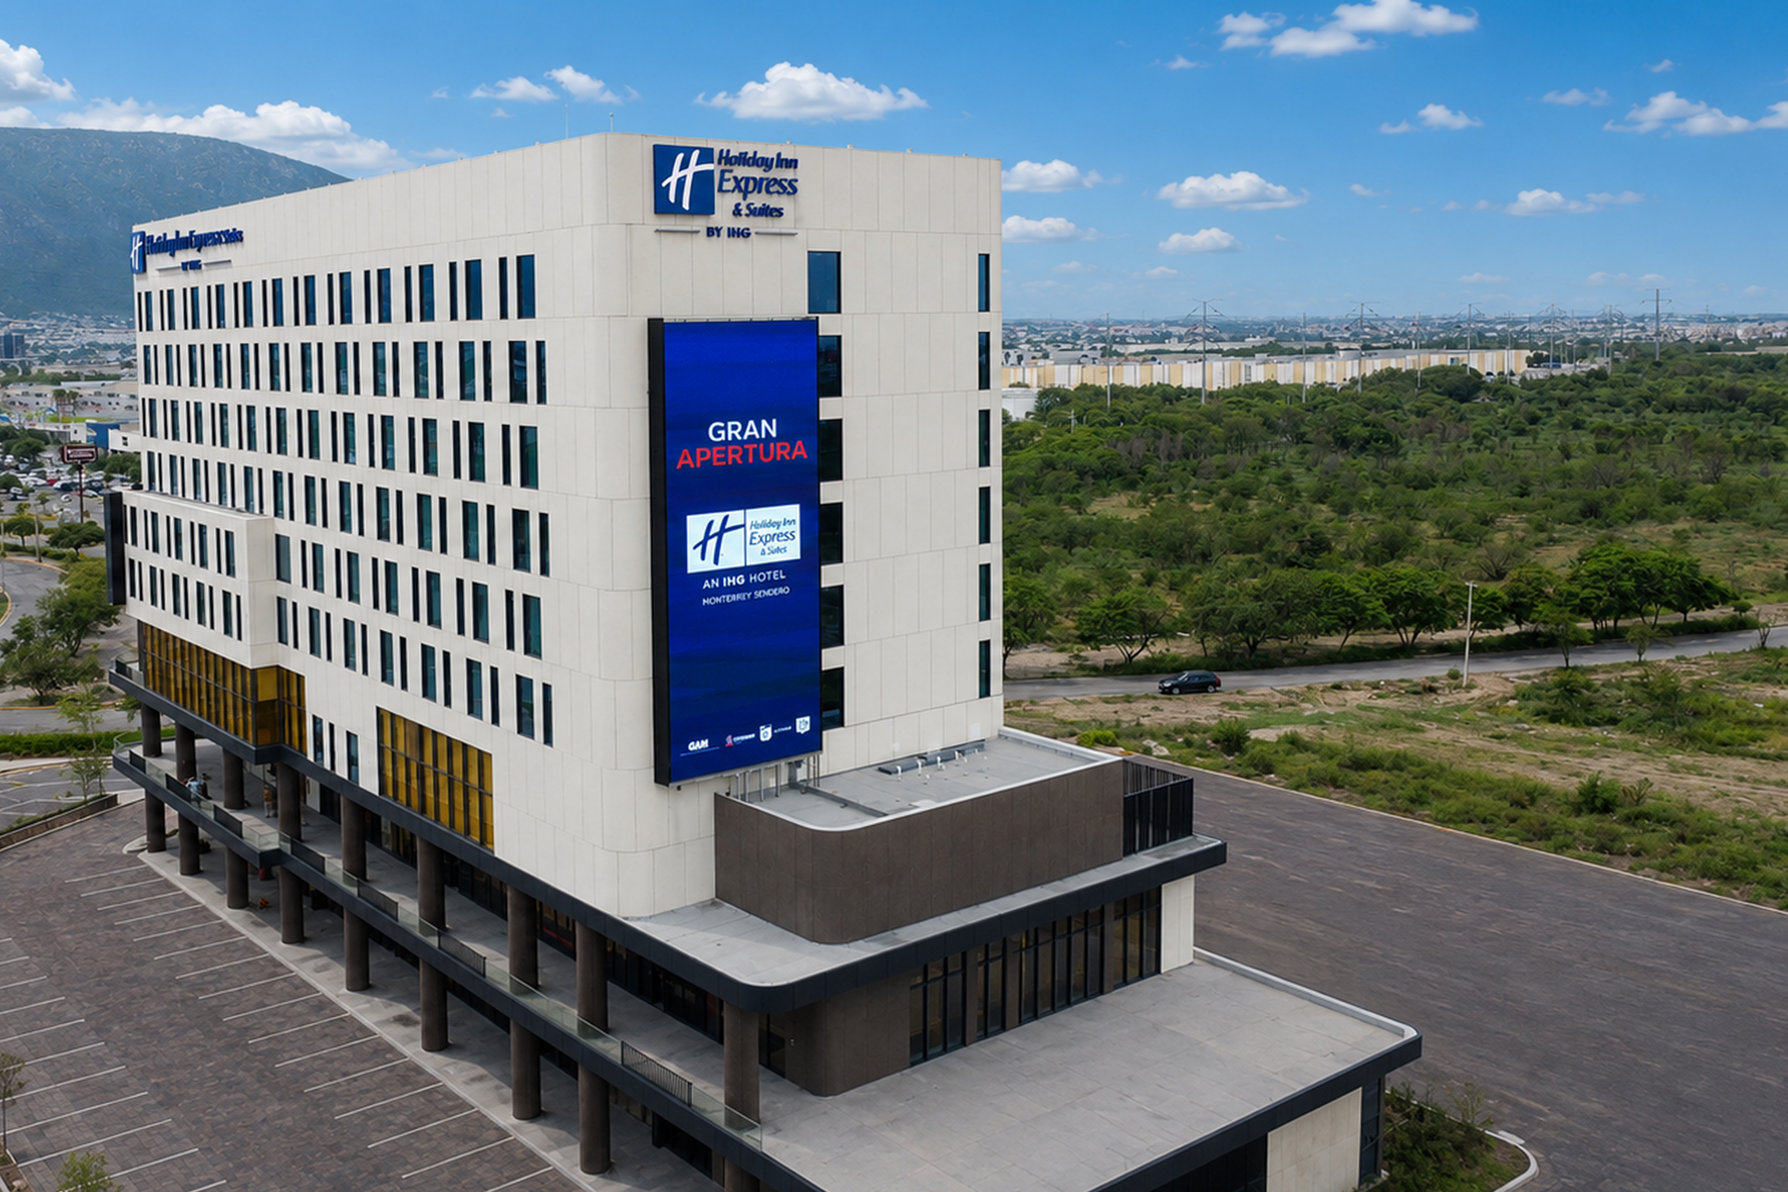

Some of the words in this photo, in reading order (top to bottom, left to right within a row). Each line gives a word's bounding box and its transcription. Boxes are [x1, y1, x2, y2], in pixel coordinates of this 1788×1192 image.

[717, 148, 774, 173] Holiday
[775, 151, 799, 170] Inn
[717, 169, 799, 201] Express
[732, 202, 742, 217] &
[744, 202, 784, 218] Suites
[706, 226, 723, 239] BY
[707, 418, 777, 442] GRAN
[675, 439, 808, 470] APERTURA
[749, 530, 796, 547] Express
[702, 578, 720, 590] AN
[723, 574, 746, 588] IHG
[749, 569, 787, 584] HOTEL
